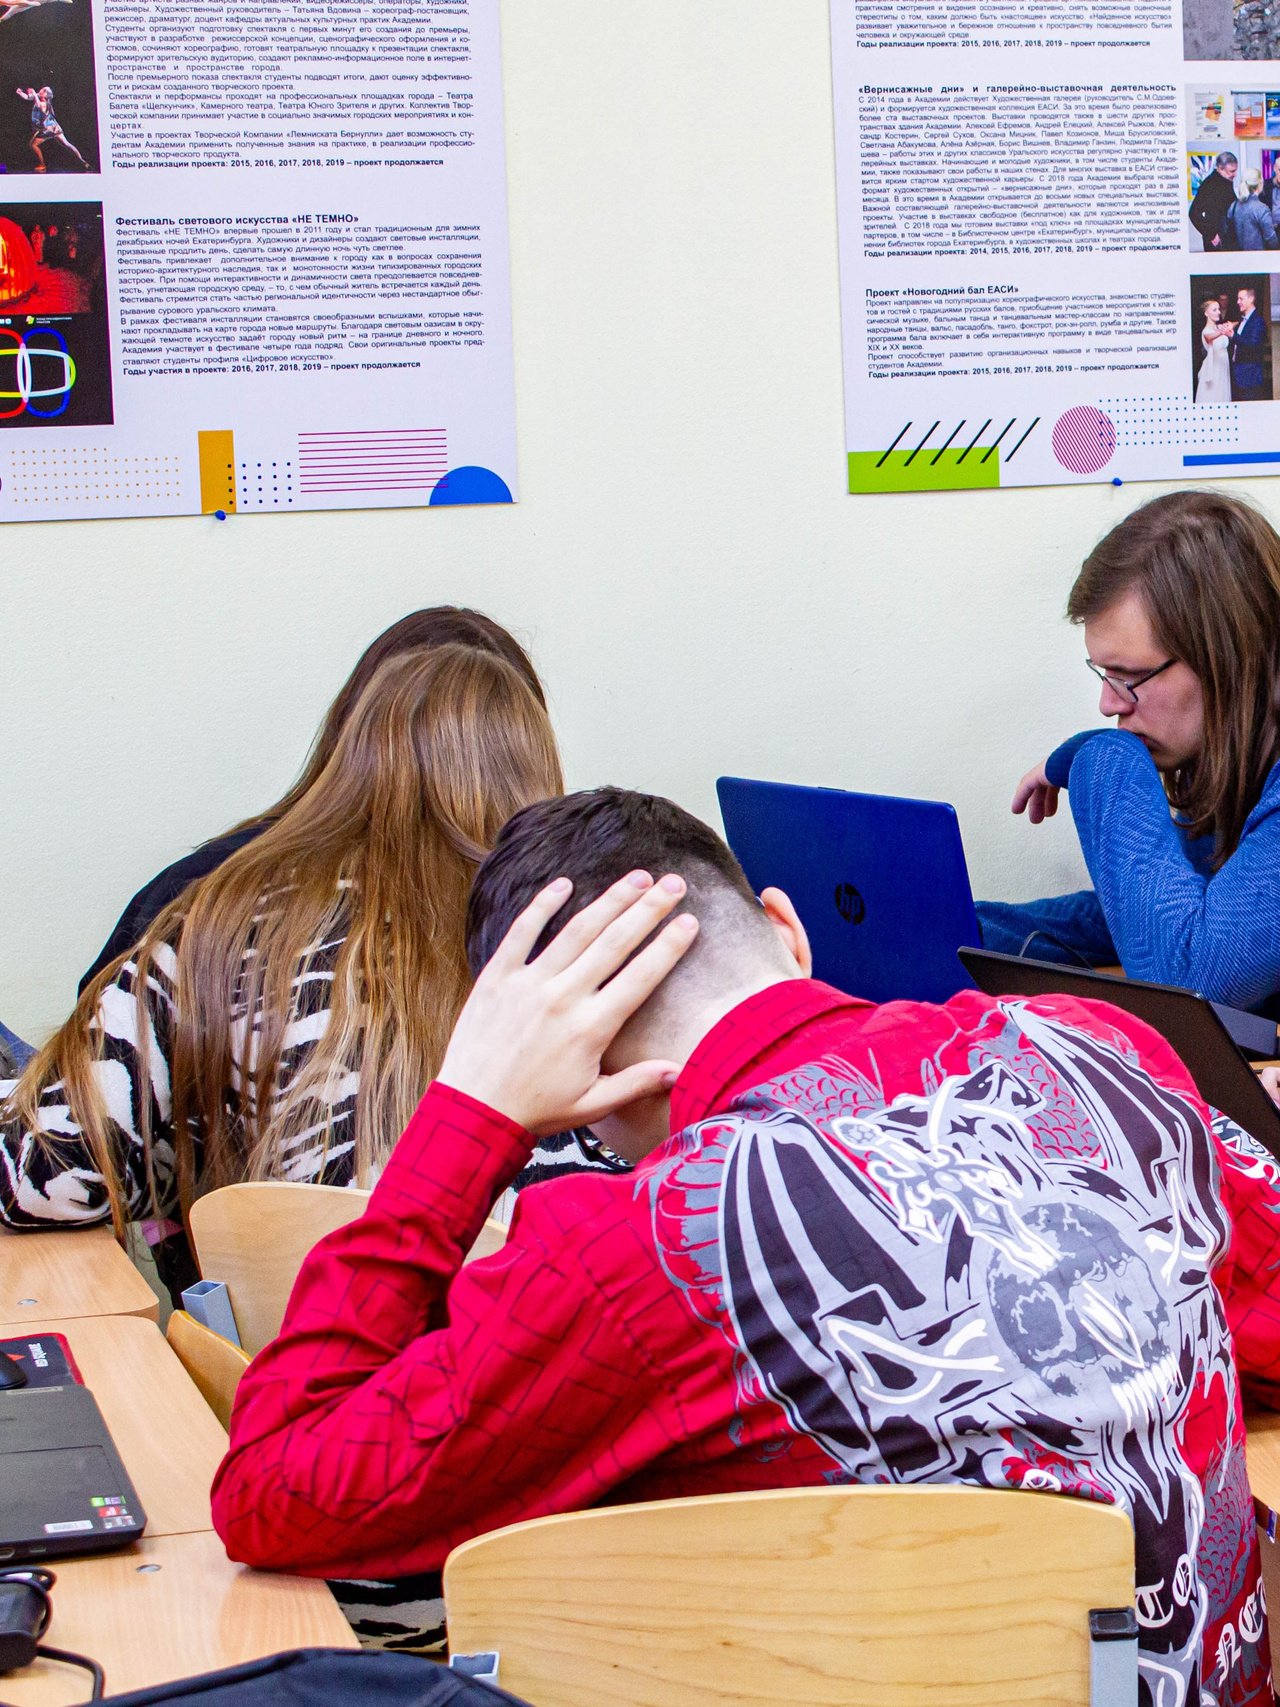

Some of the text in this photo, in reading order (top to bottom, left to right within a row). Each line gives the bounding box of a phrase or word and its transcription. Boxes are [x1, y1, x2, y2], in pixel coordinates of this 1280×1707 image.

[103, 4, 152, 14] дизайнеры.
[154, 4, 224, 15] Художественный
[226, 7, 282, 15] руководитель
[292, 5, 324, 13] Татьяна
[326, 5, 361, 15] Вдовина
[371, 6, 470, 16] хореограф-постановщик,
[856, 39, 877, 48] Годы
[878, 41, 924, 49] реализации
[926, 41, 959, 49] проекта:
[960, 39, 980, 48] 2015,
[982, 39, 1002, 48] 2016,
[1003, 38, 1022, 48] 2017,
[1024, 38, 1044, 48] 2018,
[1045, 38, 1062, 46] 2019
[1070, 40, 1096, 48] проект
[1097, 40, 1150, 48] продолжается
[858, 84, 933, 95] «Вернисажные
[940, 86, 964, 94] дни»
[986, 83, 1103, 94] галерейно-выставочная
[1110, 84, 1176, 93] деятельность
[867, 95, 885, 103] 2014
[914, 95, 950, 104] Академии
[952, 94, 989, 104] действует
[992, 94, 1050, 103] Художественная
[1053, 95, 1082, 103] галерея
[1084, 93, 1134, 103] (руководитель
[112, 159, 135, 169] Годы
[137, 160, 189, 170] реализации
[191, 160, 228, 169] проекта:
[230, 158, 252, 168] 2015,
[254, 157, 276, 168] 2016,
[278, 157, 300, 168] 2017,
[302, 157, 323, 168] 2018,
[325, 157, 345, 166] 2019
[353, 159, 382, 168] проект
[384, 158, 444, 168] продолжается
[115, 215, 176, 225] Фестиваль
[235, 216, 289, 226] искусства
[291, 213, 312, 223] «НЕ
[314, 213, 359, 223] ТЕМНО»
[115, 227, 160, 236] Фестиваль
[163, 227, 181, 235] «НЕ
[183, 226, 220, 235] ТЕМНО»
[223, 228, 258, 236] впервые
[261, 227, 292, 236] прошел
[303, 225, 321, 233] 2011
[325, 227, 342, 235] году
[374, 225, 432, 234] традиционным
[435, 225, 450, 233] для
[864, 248, 884, 258] Годы
[886, 249, 932, 258] реализации
[934, 248, 967, 257] проекта:
[969, 246, 989, 256] 2014,
[991, 246, 1010, 255] 2015,
[1012, 245, 1032, 255] 2016,
[1034, 245, 1052, 254] 2017,
[1055, 244, 1074, 254] 2018,
[1076, 244, 1093, 252] 2019
[1101, 245, 1126, 253] проект
[1128, 244, 1181, 253] продолжается
[865, 284, 1019, 299] Проект «Новогодний бал ЕАСИ»
[122, 345, 162, 354] Академия
[165, 346, 204, 354] участвует
[215, 342, 260, 353] фестивале
[262, 343, 291, 352] четыре
[294, 343, 312, 351] года
[314, 342, 345, 351] подряд.
[348, 340, 368, 348] Свои
[370, 340, 426, 349] оригинальные
[429, 339, 461, 348] проекты
[463, 339, 485, 347] пред-
[889, 342, 900, 350] XX
[163, 357, 200, 366] студенты
[203, 354, 239, 365] профиля
[241, 353, 288, 364] «Цифровое
[290, 354, 336, 363] искусство».
[122, 366, 146, 376] Годы
[147, 367, 183, 376] участия
[192, 366, 229, 375] проекте:
[231, 363, 253, 374] 2016,
[255, 362, 277, 373] 2017,
[278, 362, 301, 372] 2018,
[302, 361, 322, 370] 2019
[330, 362, 359, 372] проект
[361, 361, 421, 371] продолжается
[868, 369, 889, 379] Годы
[890, 370, 936, 379] реализации
[937, 369, 970, 378] проекта:
[972, 366, 991, 376] 2015,
[993, 365, 1012, 375] 2016,
[1014, 365, 1033, 374] 2017,
[1034, 364, 1054, 374] 2018,
[1055, 363, 1072, 372] 2019
[1080, 364, 1105, 373] проект
[1106, 363, 1159, 372] продолжается
